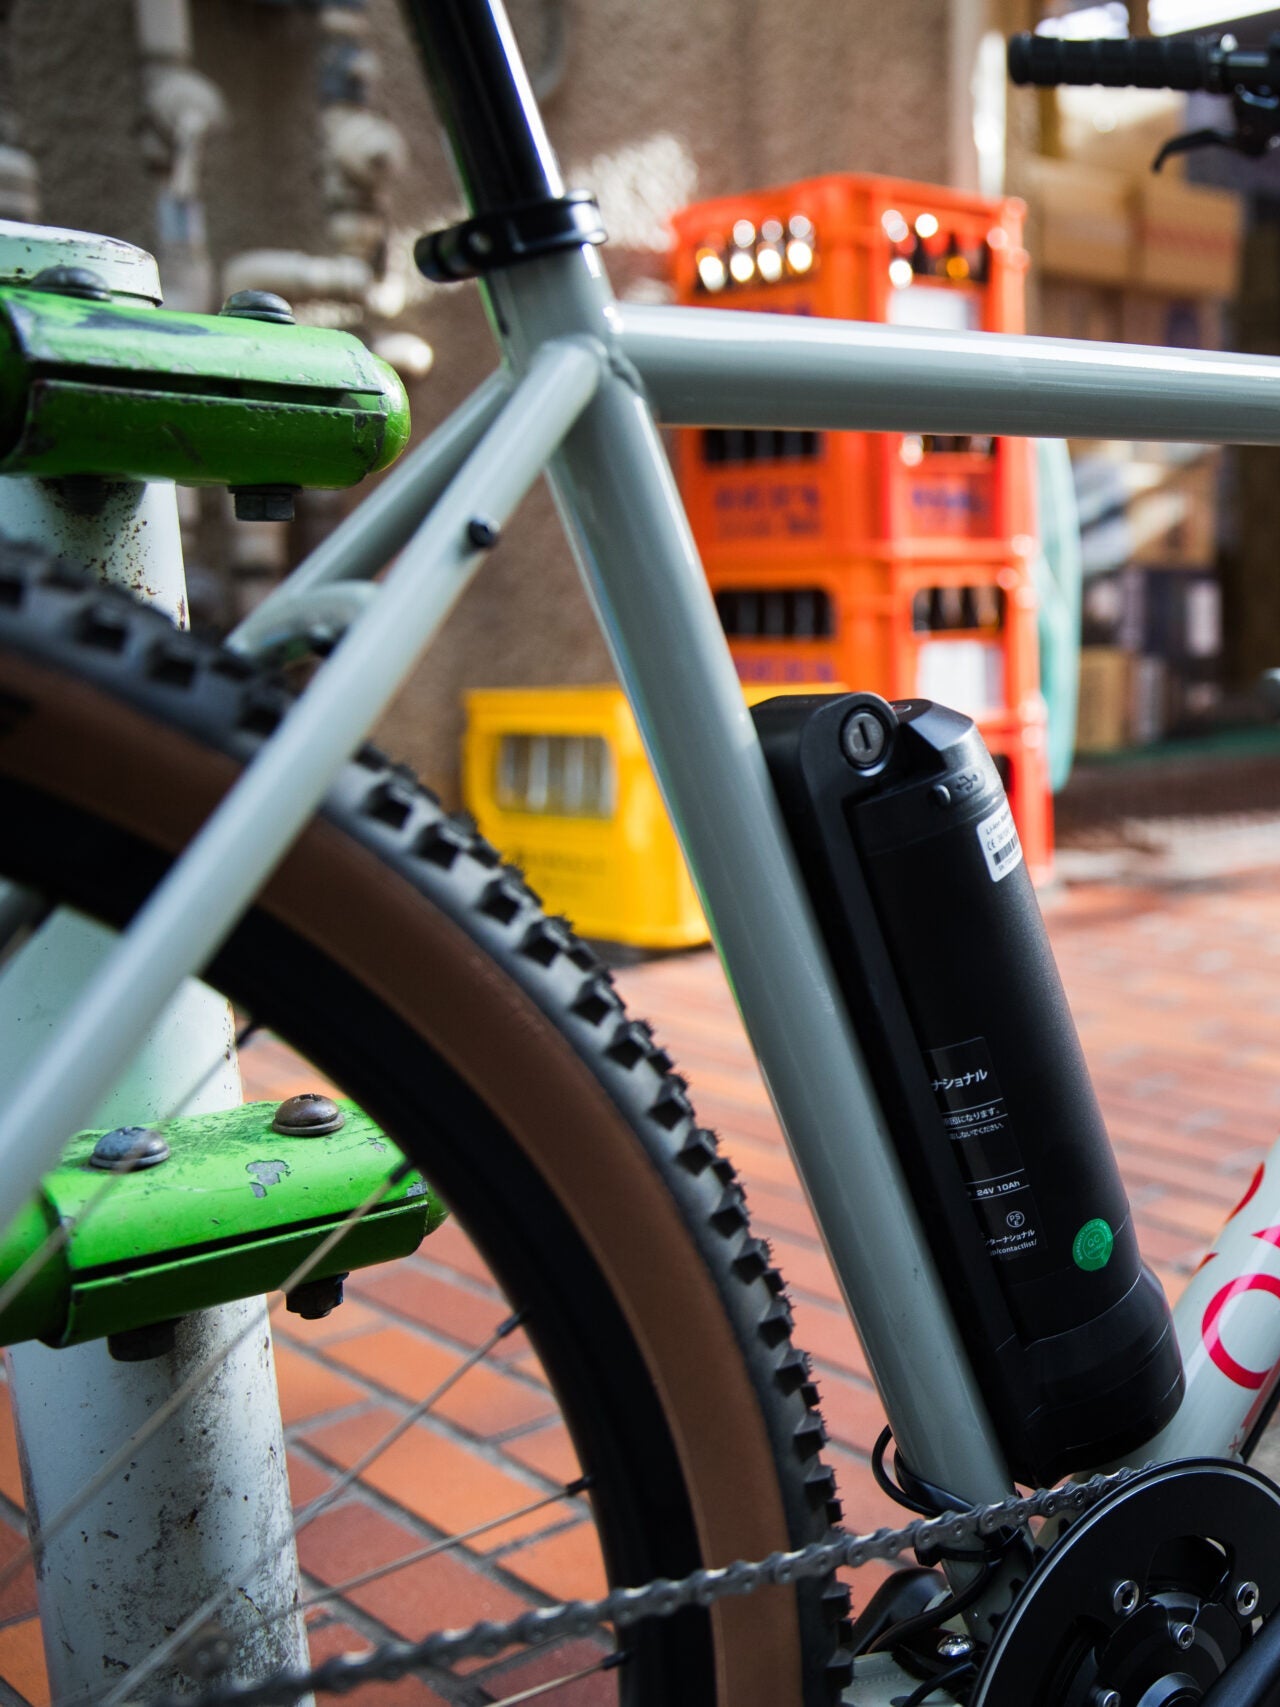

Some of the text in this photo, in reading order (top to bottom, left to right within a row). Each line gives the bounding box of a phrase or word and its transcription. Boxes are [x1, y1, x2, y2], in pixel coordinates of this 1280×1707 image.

[976, 1180, 1021, 1197] 24V 10Ah
[1087, 1233, 1101, 1249] QC
